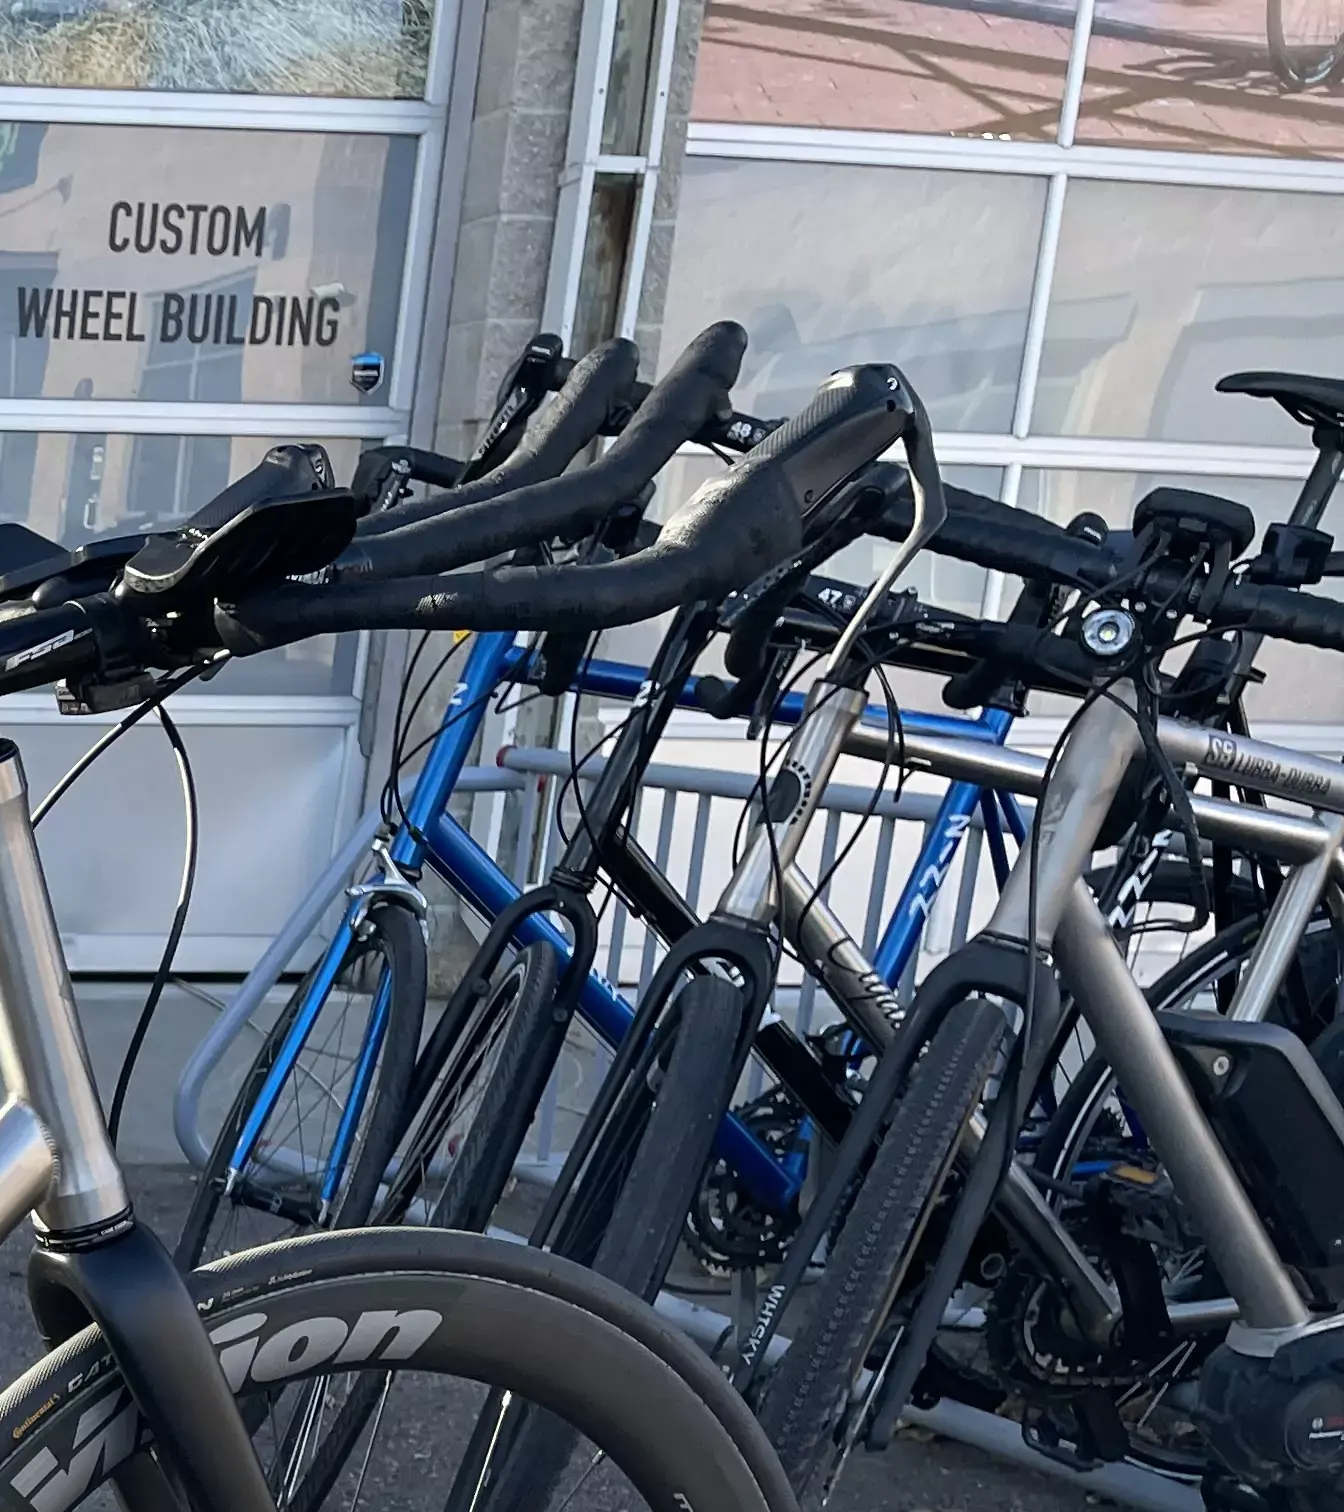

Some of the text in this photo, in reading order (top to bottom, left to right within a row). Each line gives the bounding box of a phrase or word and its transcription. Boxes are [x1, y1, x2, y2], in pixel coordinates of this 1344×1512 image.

[108, 200, 268, 257] CUSTOM
[17, 286, 341, 348] WHEEL BUILDING
[909, 813, 972, 919] ZINN
[739, 1283, 786, 1365] WHISKY
